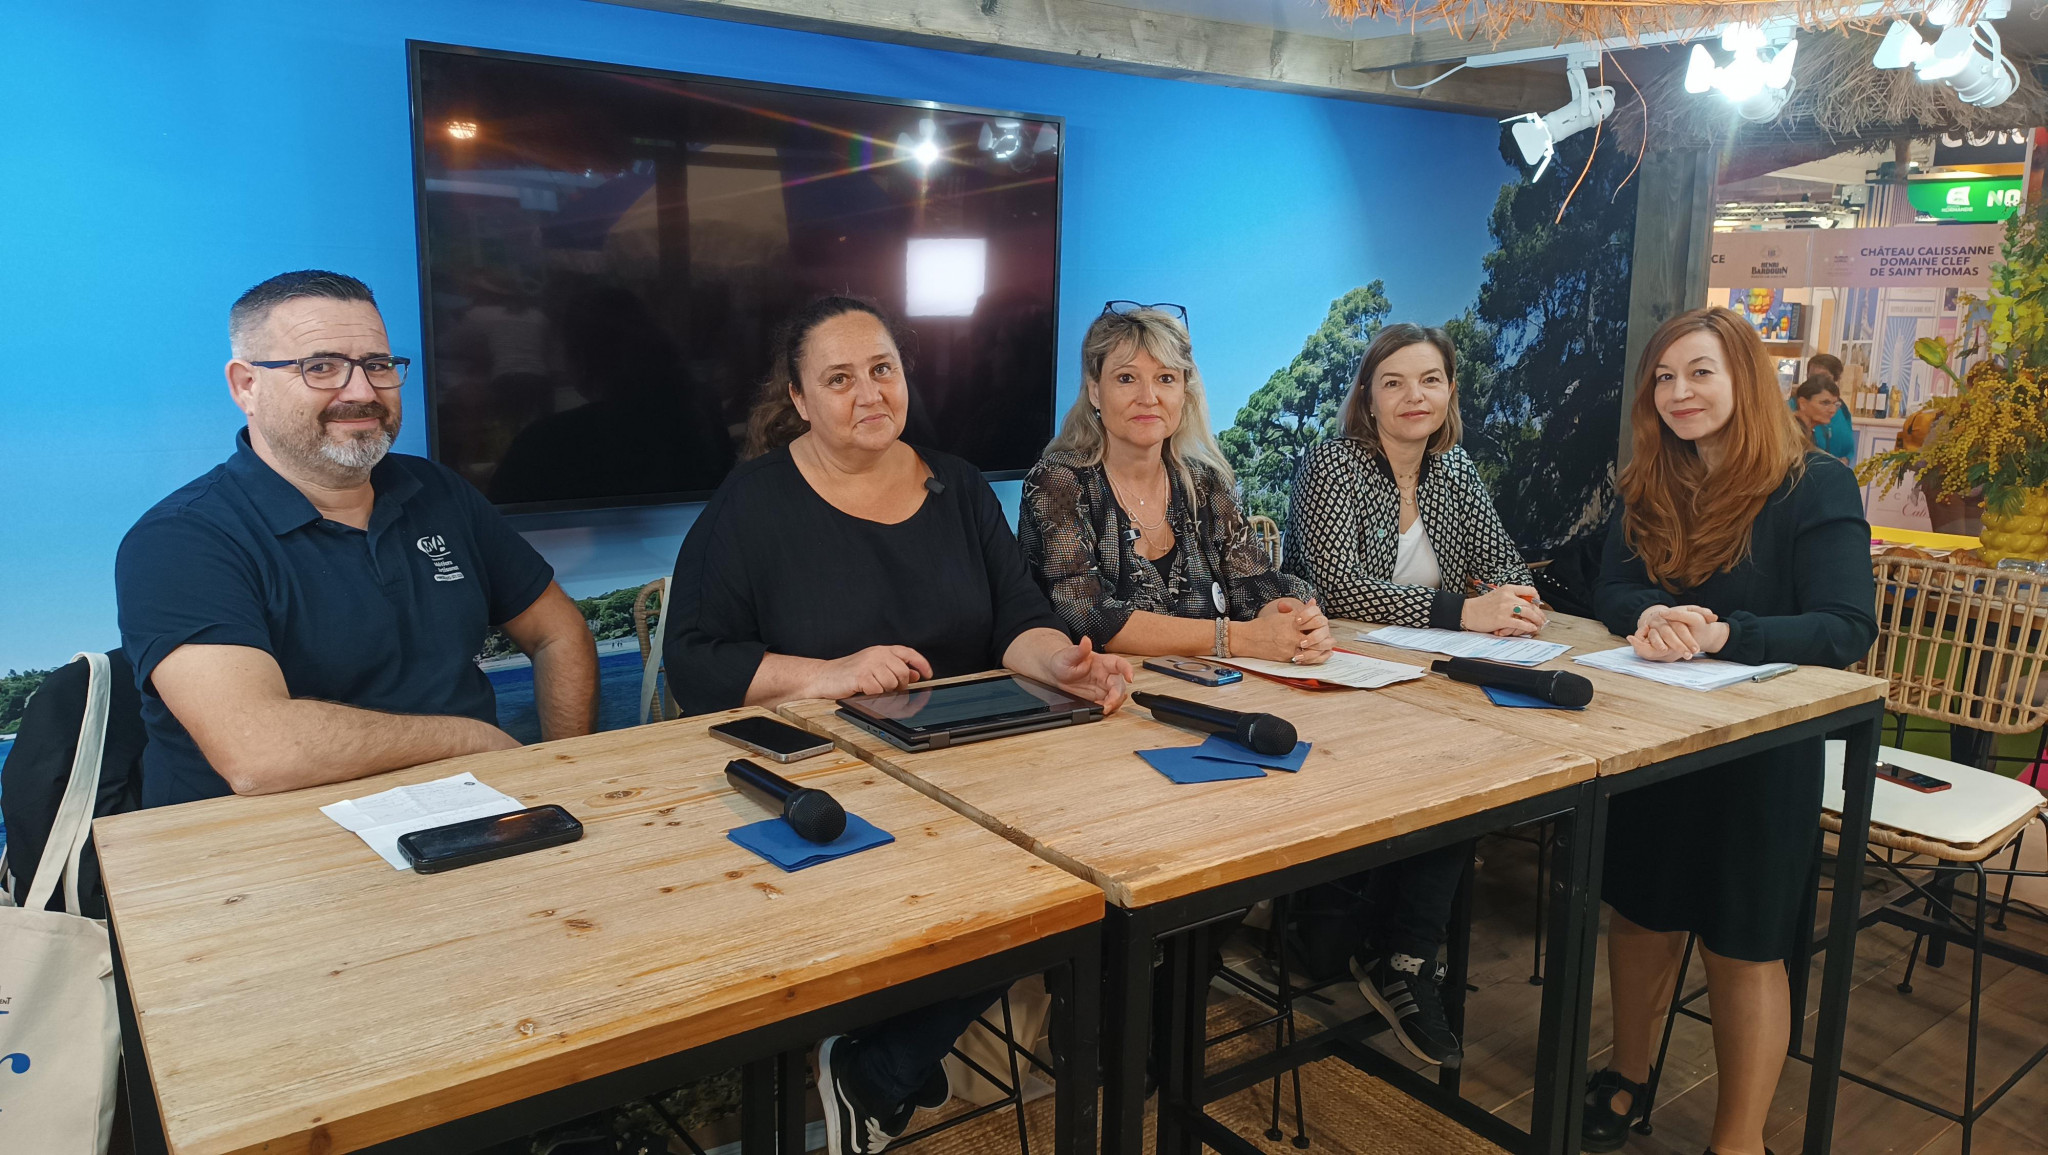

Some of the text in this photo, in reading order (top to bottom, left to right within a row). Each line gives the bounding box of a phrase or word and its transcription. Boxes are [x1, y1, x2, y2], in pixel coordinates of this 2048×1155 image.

[1860, 245, 1995, 257] CHÂTEAU CALISSANNE
[1711, 254, 1726, 264] CE
[1880, 256, 1971, 267] DOMAINE CLEF
[1870, 266, 1979, 277] DE SAINT THOMAS
